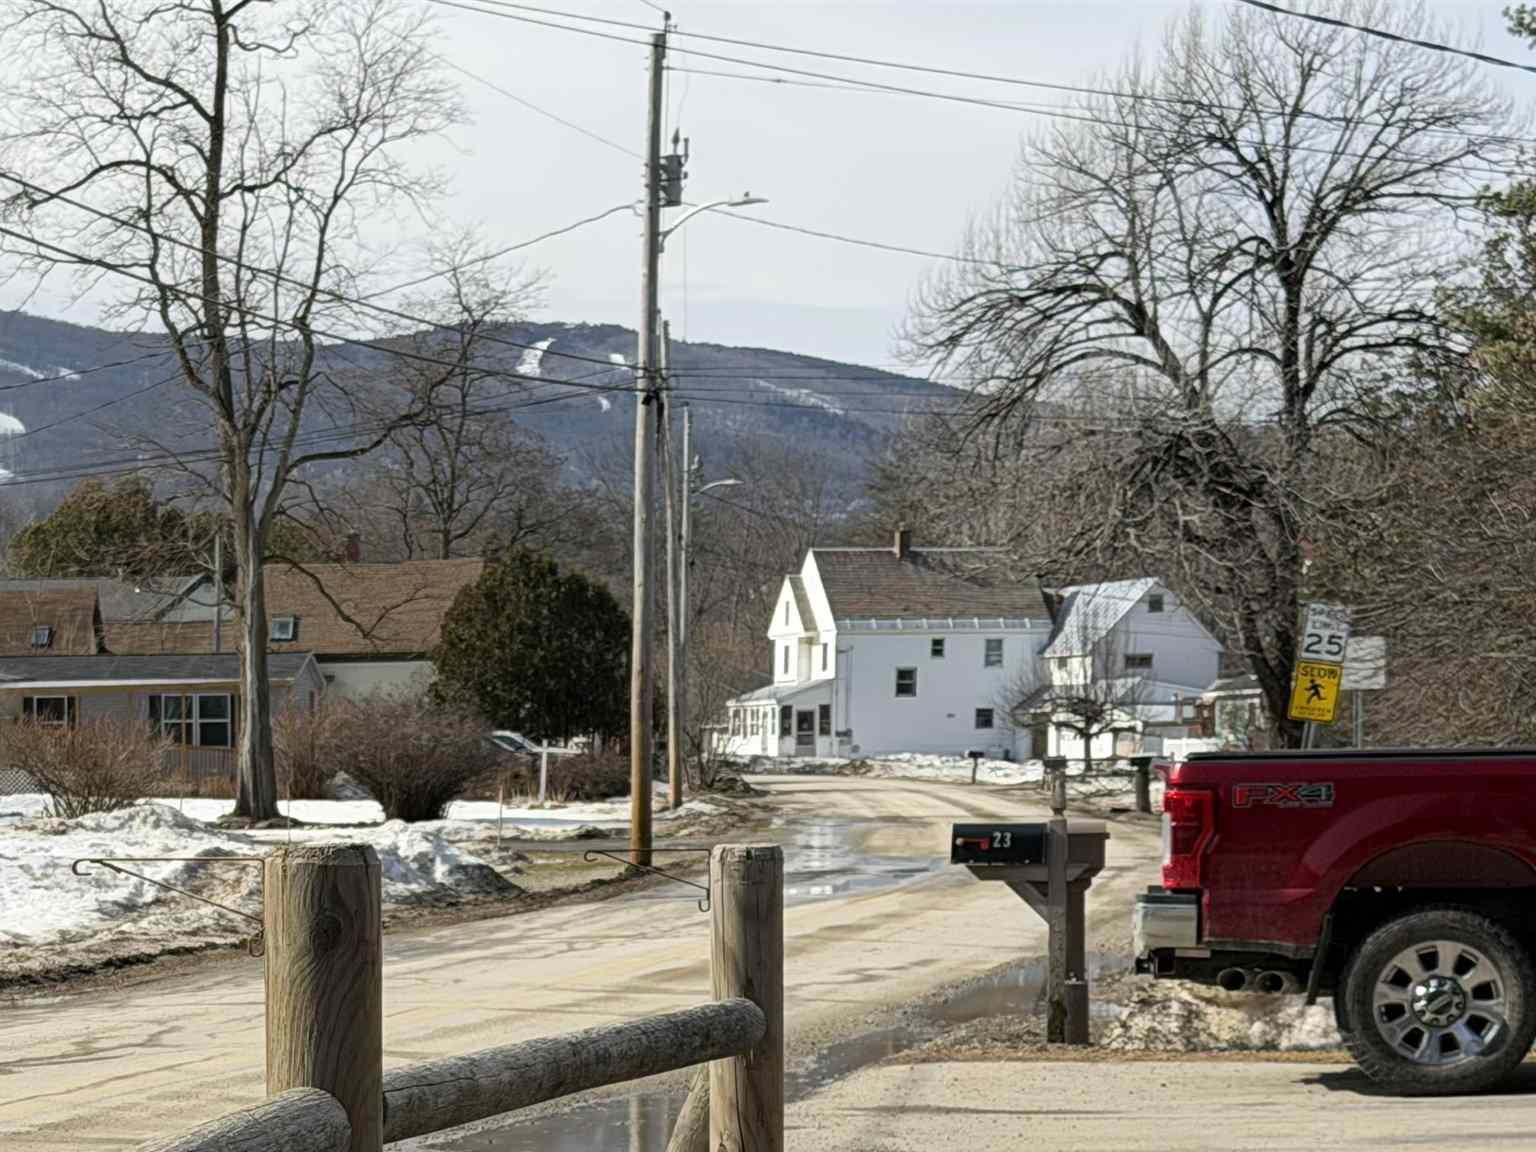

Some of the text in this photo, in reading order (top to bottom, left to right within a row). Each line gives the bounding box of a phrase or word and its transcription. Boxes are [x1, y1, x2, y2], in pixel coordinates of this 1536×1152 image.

[1304, 633, 1344, 656] 25
[1301, 665, 1338, 679] SLOW
[1232, 783, 1335, 808] FX4
[992, 831, 1012, 848] 23
